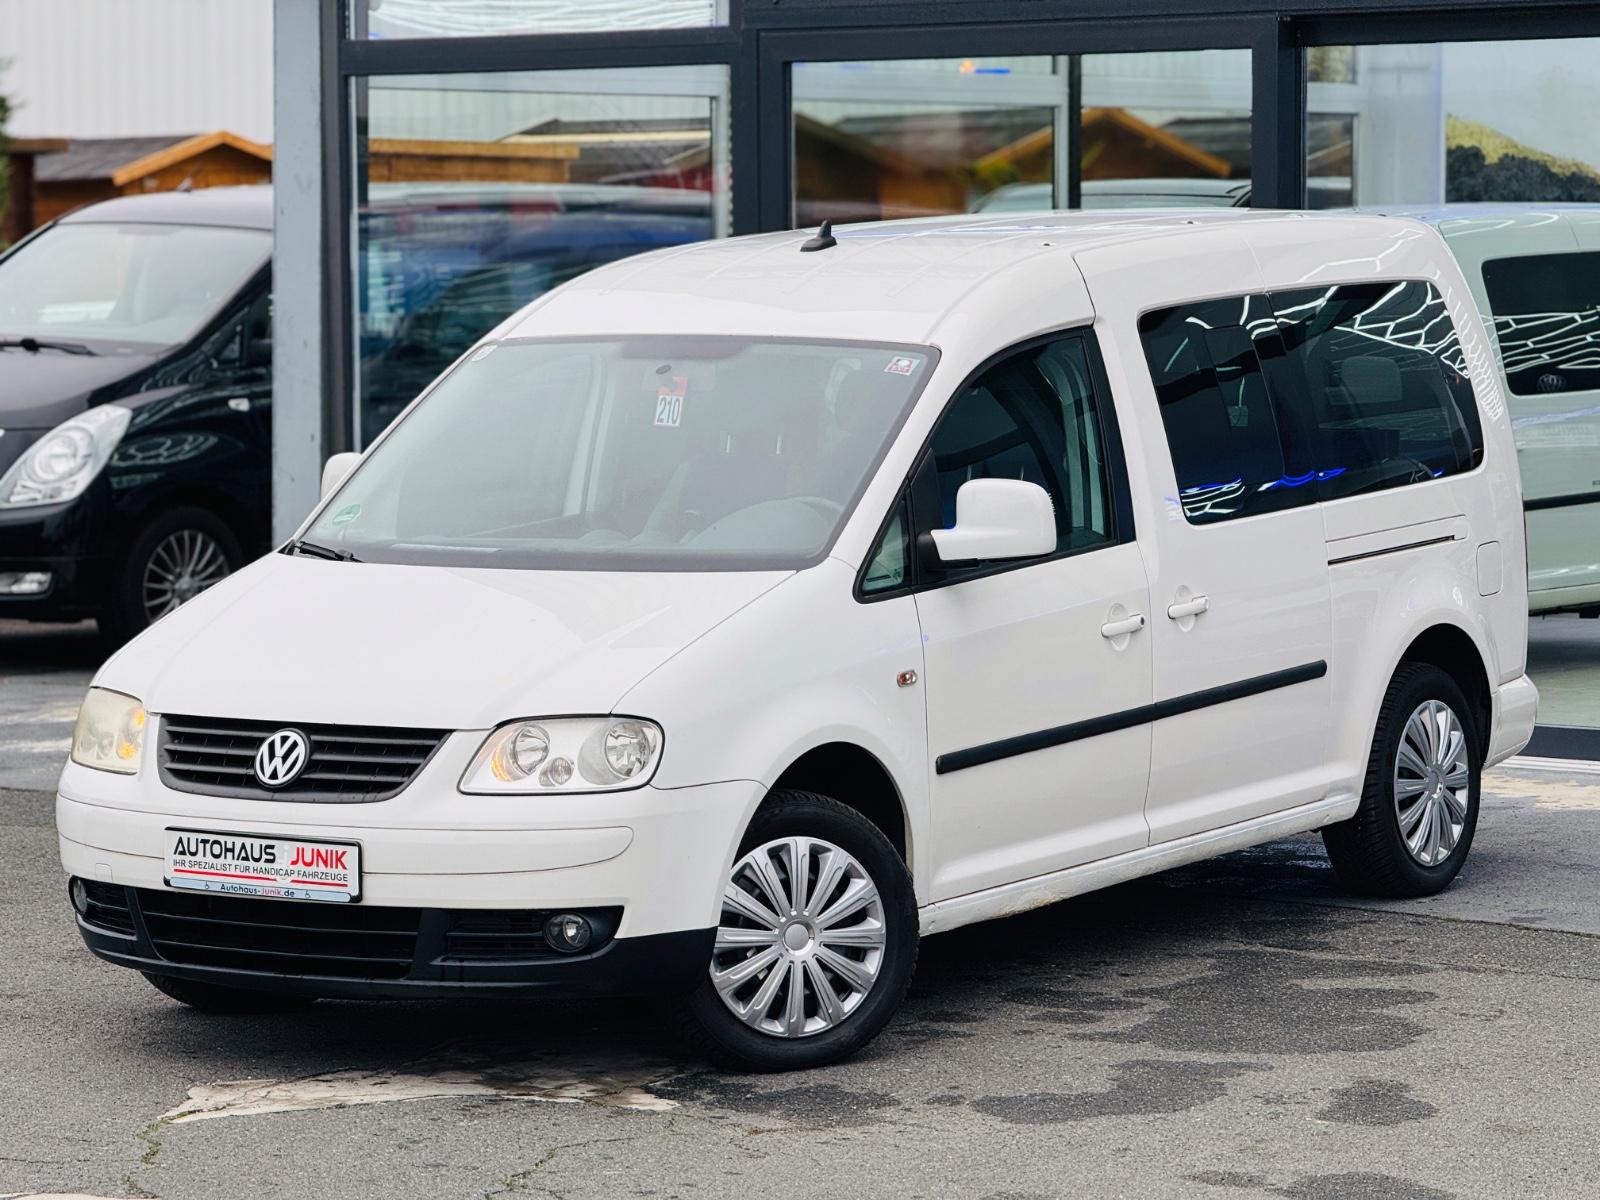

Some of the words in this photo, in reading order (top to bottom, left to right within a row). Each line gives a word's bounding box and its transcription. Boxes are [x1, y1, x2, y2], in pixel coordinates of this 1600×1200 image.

[657, 397, 680, 424] 210
[258, 731, 305, 784] VW
[173, 836, 276, 864] AUTOHAUS
[290, 847, 347, 870] JUNIK
[173, 859, 187, 868] IHR
[188, 860, 232, 871] SPEZIALIST
[252, 866, 295, 877] HANDICAP
[297, 870, 348, 882] FAHRZEUGE
